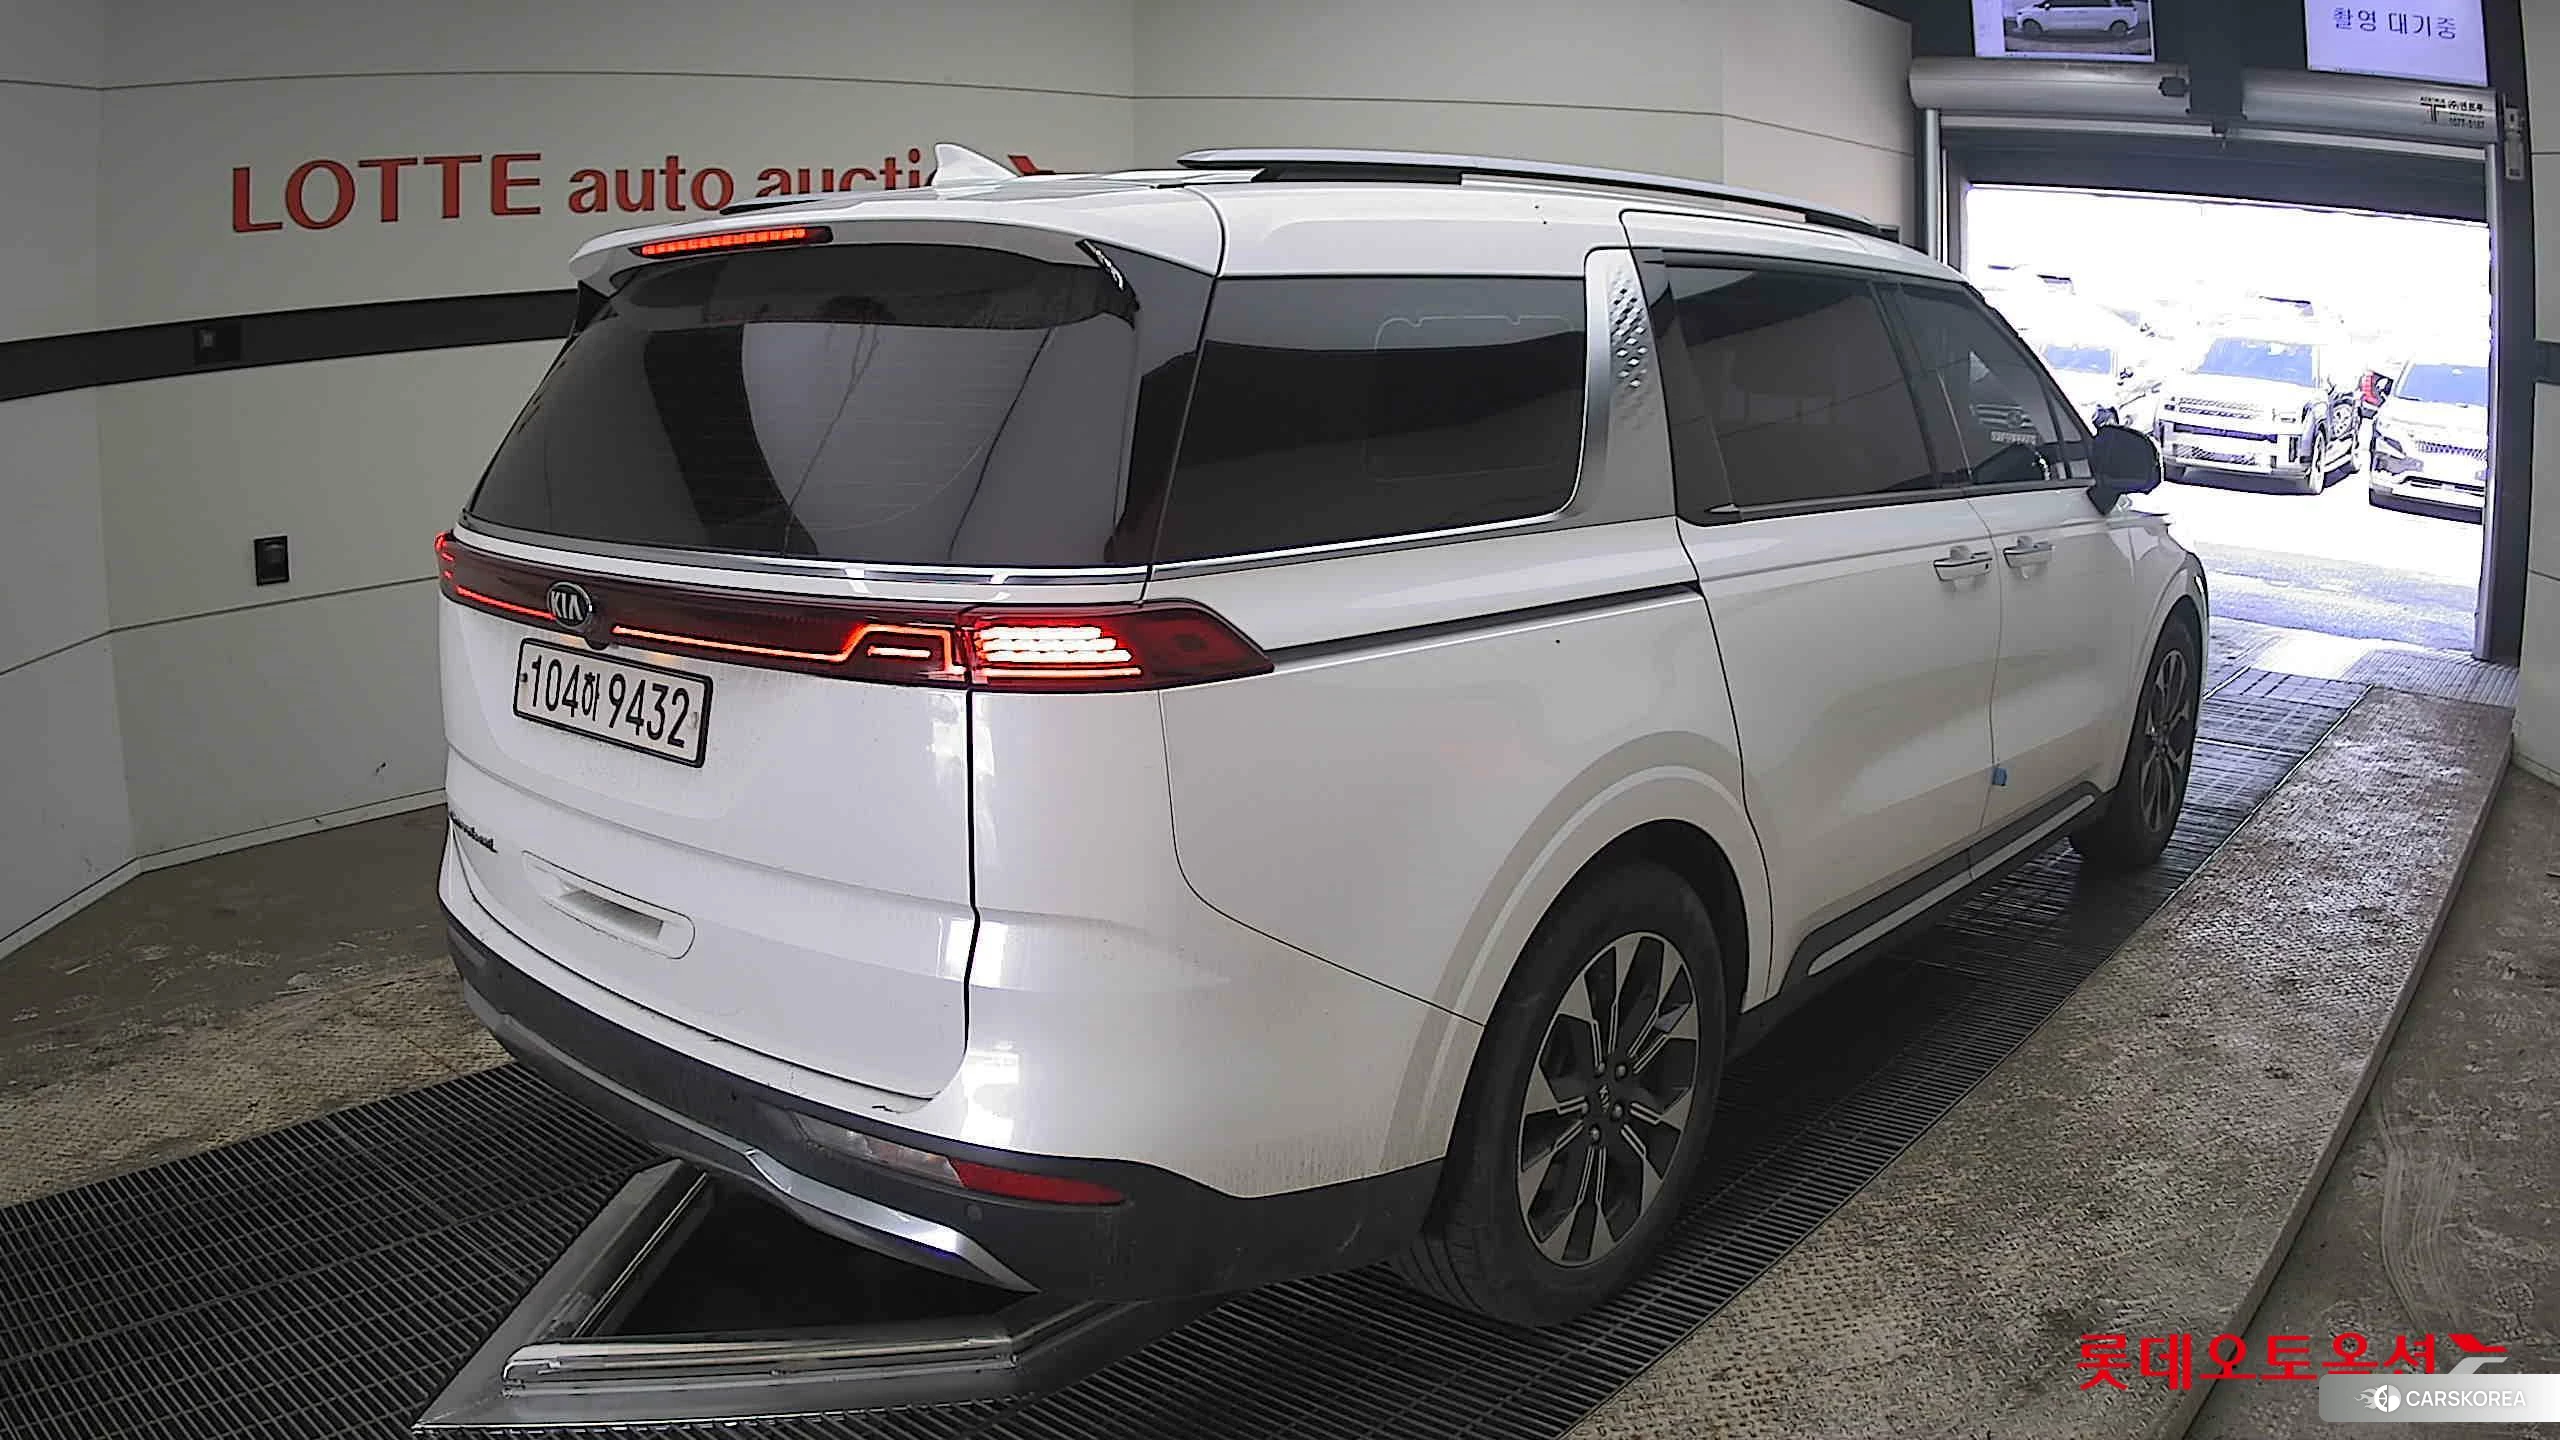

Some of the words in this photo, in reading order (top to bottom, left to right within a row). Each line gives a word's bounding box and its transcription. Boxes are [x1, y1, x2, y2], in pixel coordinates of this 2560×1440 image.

[2335, 8, 2376, 32] 촬영
[2388, 13, 2456, 40] 대기중
[233, 153, 541, 233] LOTTE
[569, 155, 735, 213] auto
[755, 148, 938, 198] aucti
[551, 591, 584, 622] KIA
[532, 655, 600, 722] 104하
[608, 674, 690, 748] 9432
